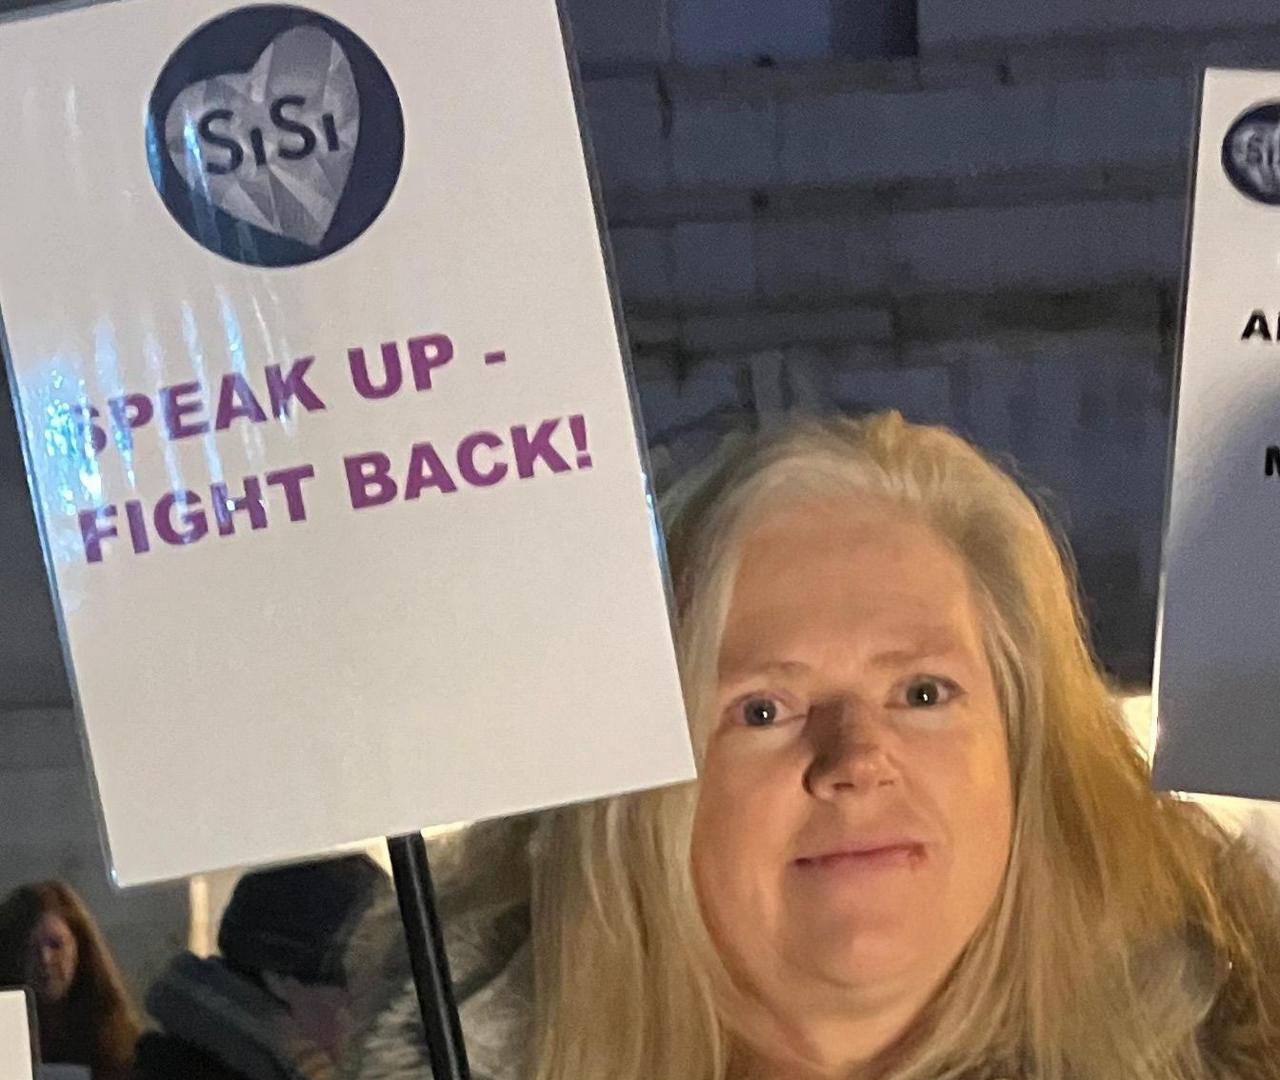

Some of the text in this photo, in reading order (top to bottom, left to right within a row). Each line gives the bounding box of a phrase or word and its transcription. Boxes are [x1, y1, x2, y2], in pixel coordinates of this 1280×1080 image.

[349, 332, 455, 400] UP
[79, 415, 593, 564] FIGHT BACK!
